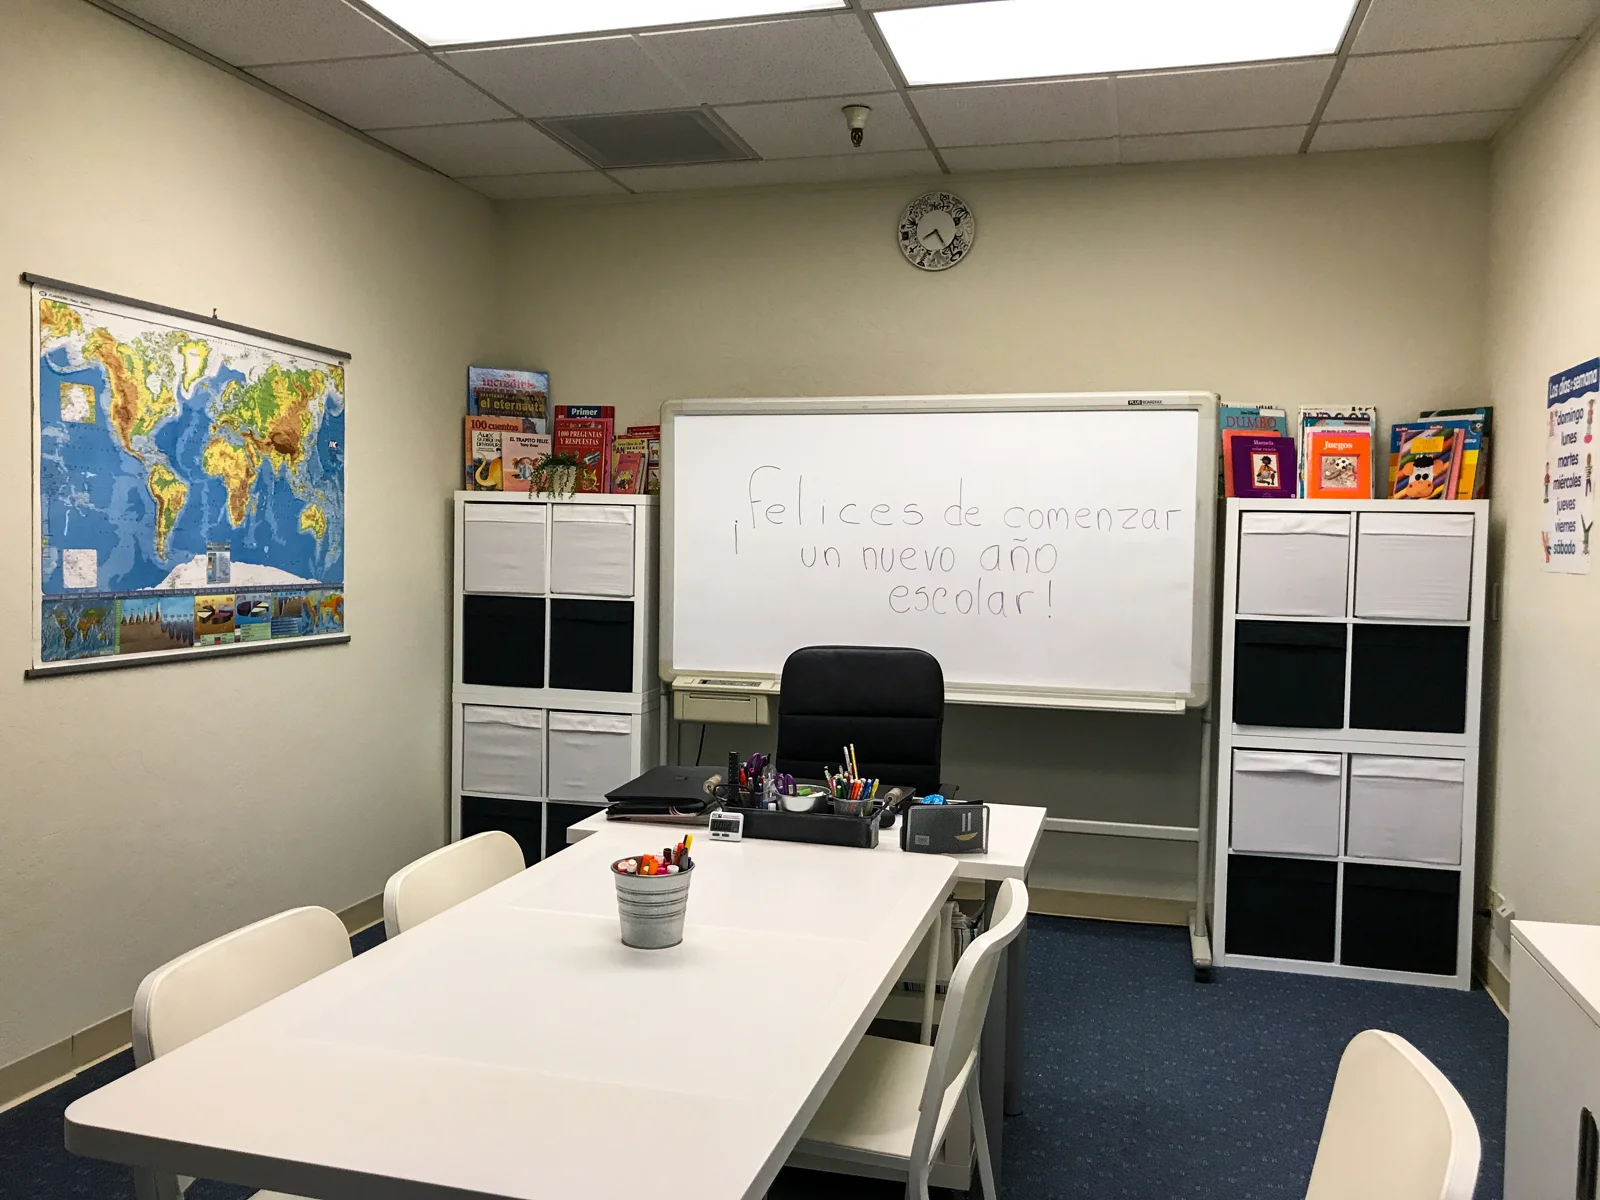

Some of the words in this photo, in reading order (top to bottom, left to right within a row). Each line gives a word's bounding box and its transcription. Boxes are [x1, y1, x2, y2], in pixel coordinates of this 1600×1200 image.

[1550, 382, 1559, 399] Los
[1573, 369, 1598, 391] semana
[480, 398, 490, 408] el
[493, 399, 546, 412] eternauta
[571, 407, 598, 416] Primer
[1225, 415, 1277, 429] DUMBO
[1557, 408, 1584, 425] domingo
[471, 419, 487, 430] 100
[488, 422, 519, 431] cuentos
[565, 438, 599, 446] RESPUESTAS
[1323, 440, 1353, 450] Juegos
[1561, 431, 1578, 446] lunes
[1557, 452, 1579, 468] martes
[1552, 472, 1582, 490] miércoles
[943, 478, 981, 527] de
[1003, 506, 1182, 532] comenzar
[1556, 496, 1576, 515] jueves
[1554, 518, 1576, 532] viernes
[1553, 539, 1576, 555] sábado
[800, 545, 841, 568] un
[862, 545, 956, 572] nuevo
[979, 537, 1058, 574] año
[888, 577, 1053, 618] escolar!
